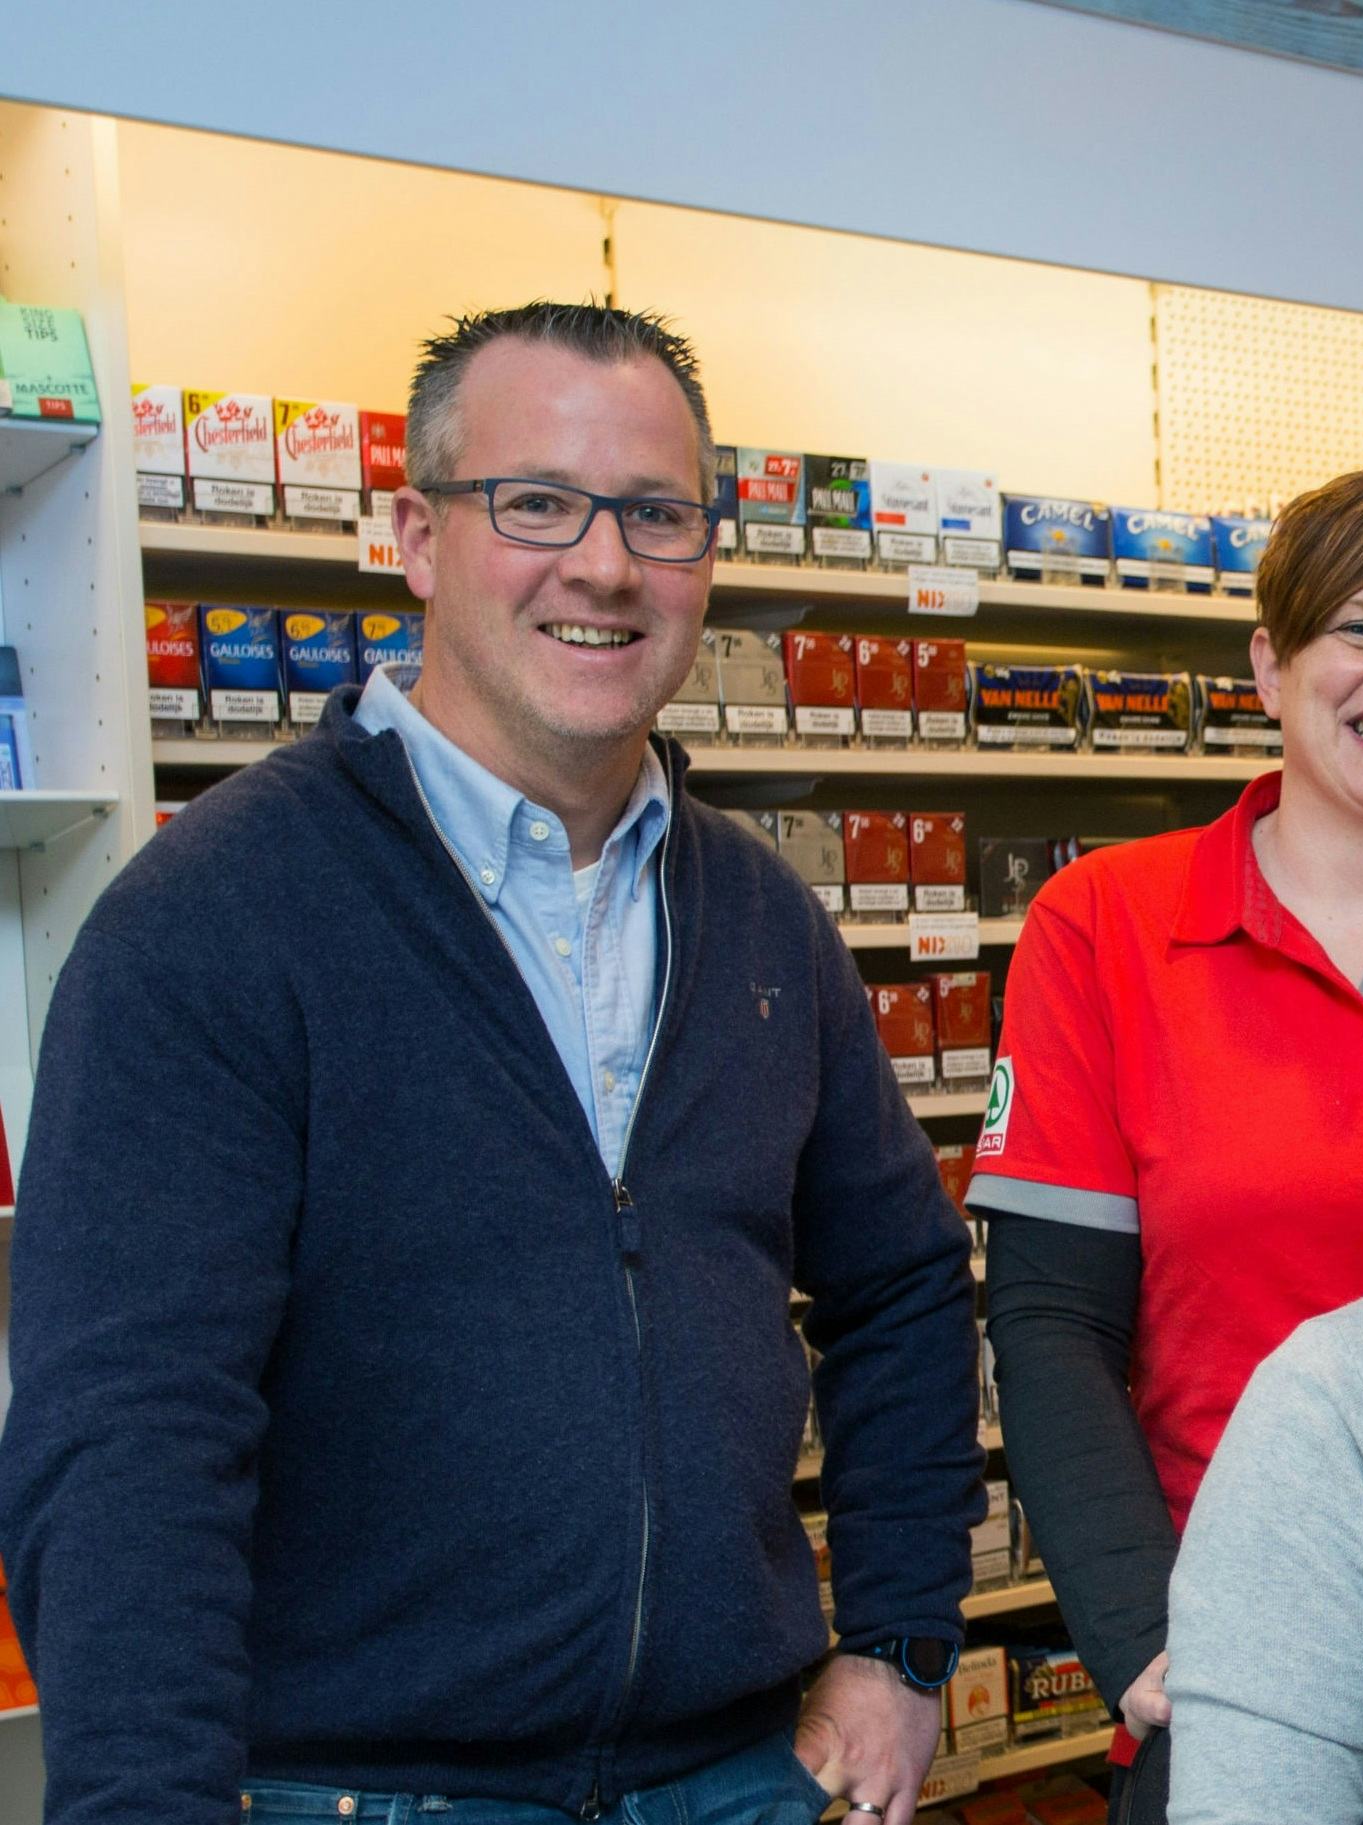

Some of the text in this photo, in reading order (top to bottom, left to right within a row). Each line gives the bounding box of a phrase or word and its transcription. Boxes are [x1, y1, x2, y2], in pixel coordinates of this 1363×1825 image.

[16, 383, 89, 395] MASCOTTE
[195, 415, 268, 453] Chesterfield
[285, 421, 354, 461] Chesterfield
[1020, 502, 1094, 532] CAMEL
[1126, 513, 1199, 541] CAMEL
[210, 642, 273, 659] GAULOISES
[289, 645, 350, 664] GAULOISES
[980, 690, 1012, 707] VAN
[1096, 693, 1125, 712] VAN
[975, 1136, 1002, 1150] AR
